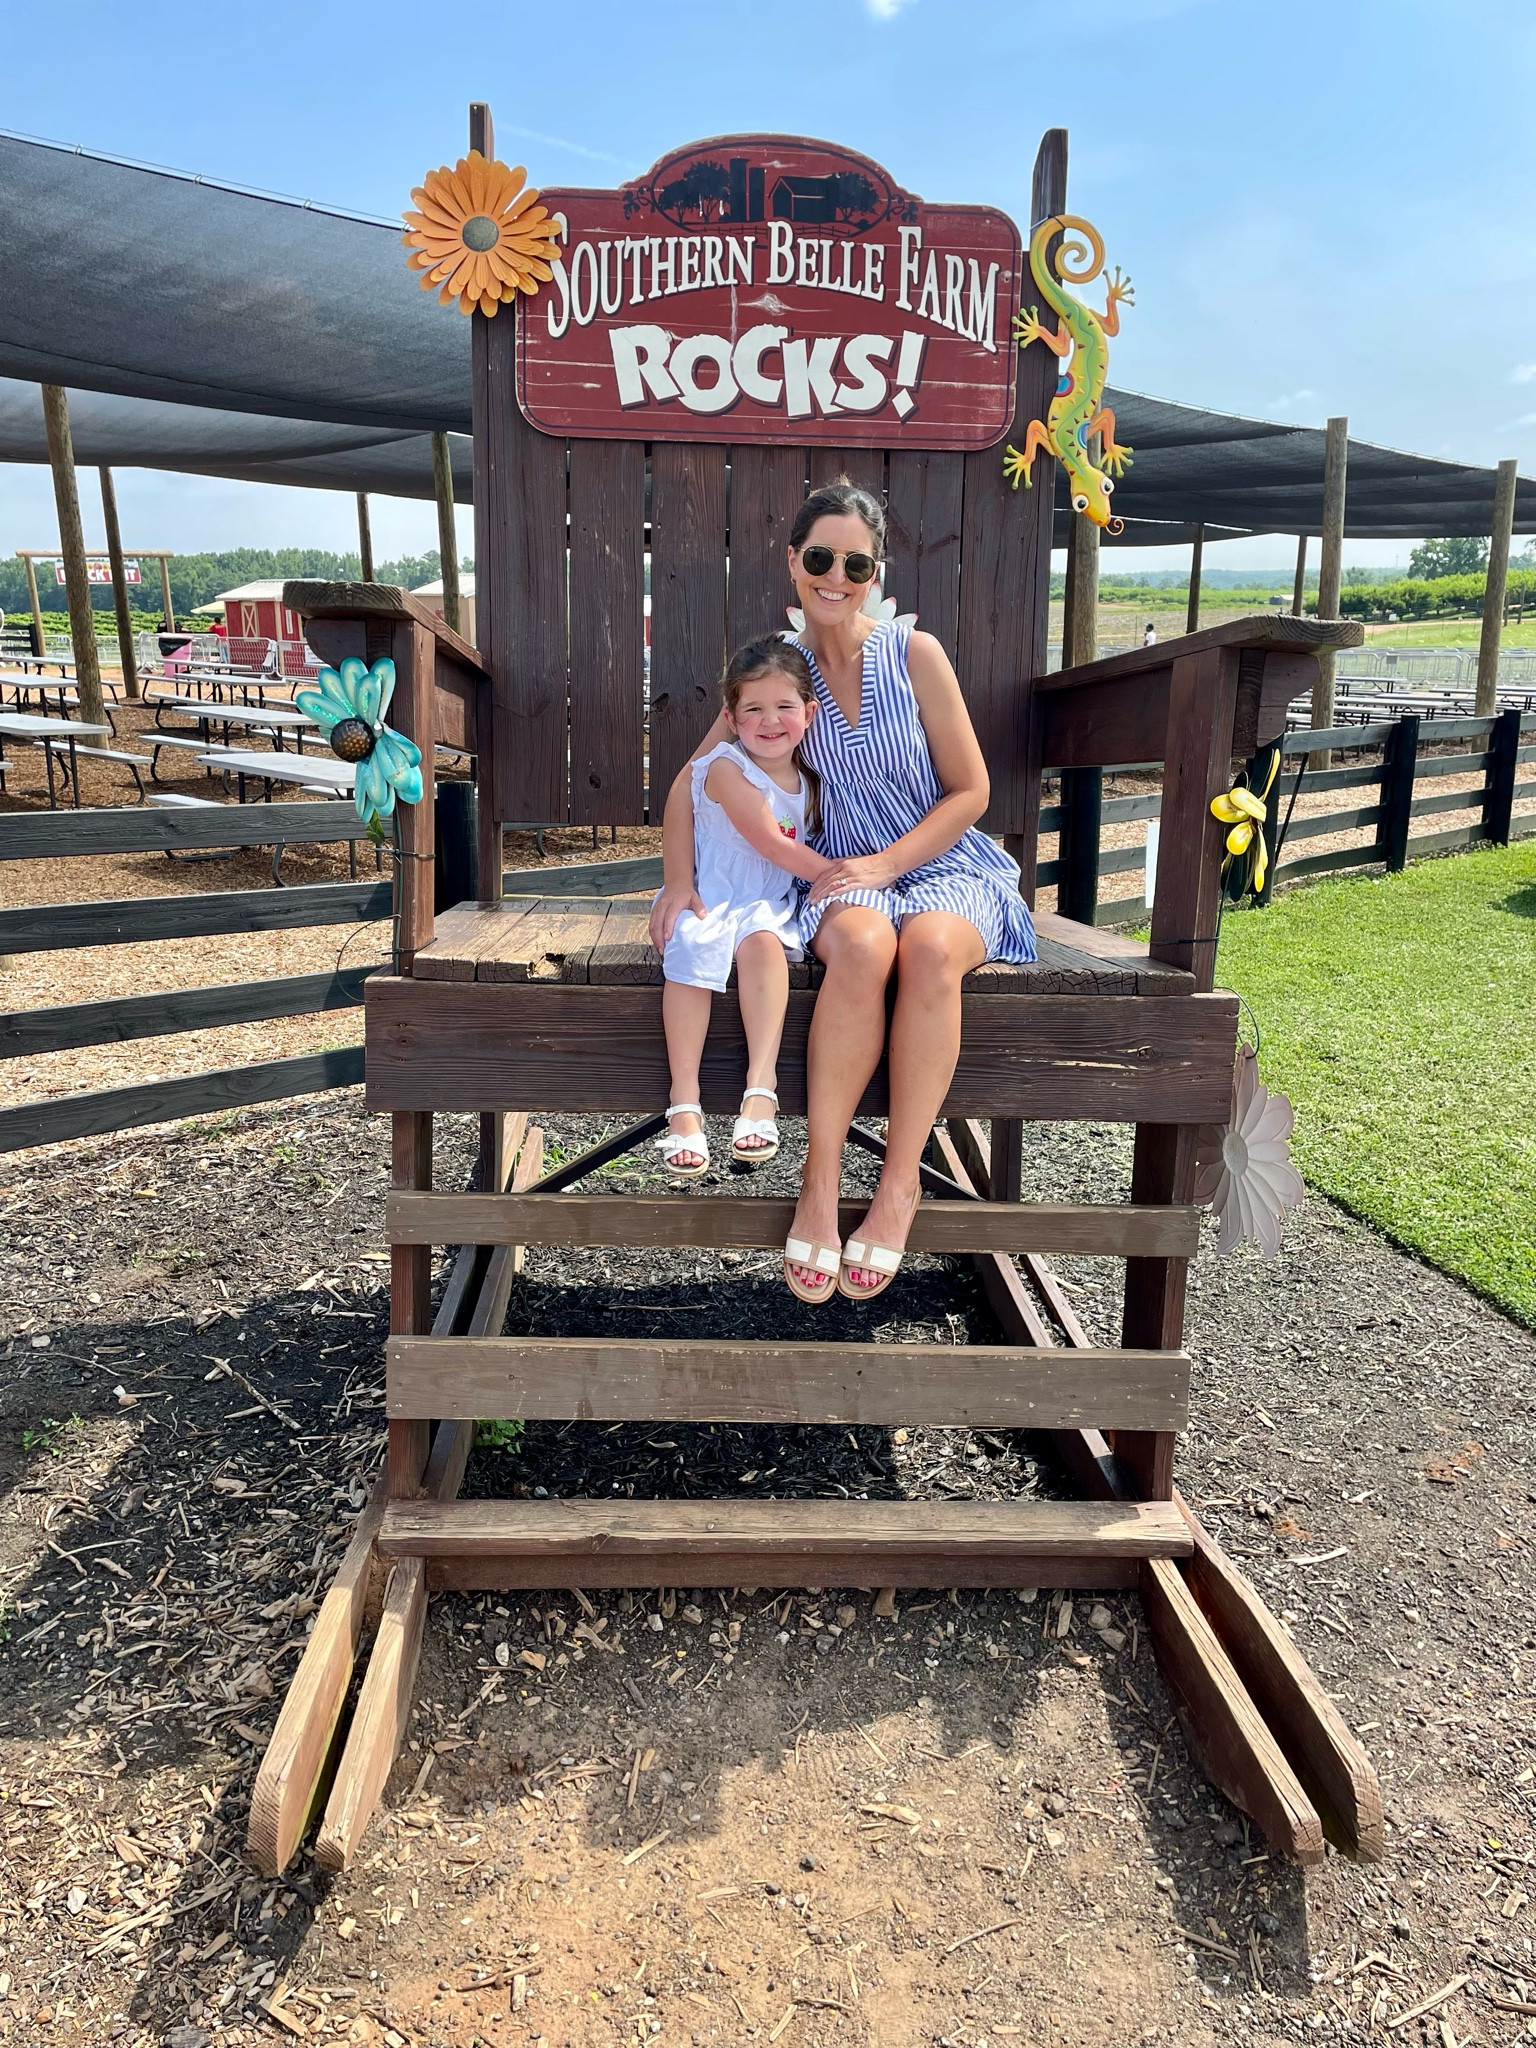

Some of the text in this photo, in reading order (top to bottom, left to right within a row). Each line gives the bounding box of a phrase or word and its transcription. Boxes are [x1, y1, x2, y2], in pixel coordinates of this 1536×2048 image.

[548, 211, 1000, 353] SOUTHERN BELLE FARM
[608, 323, 925, 418] ROCKS!
